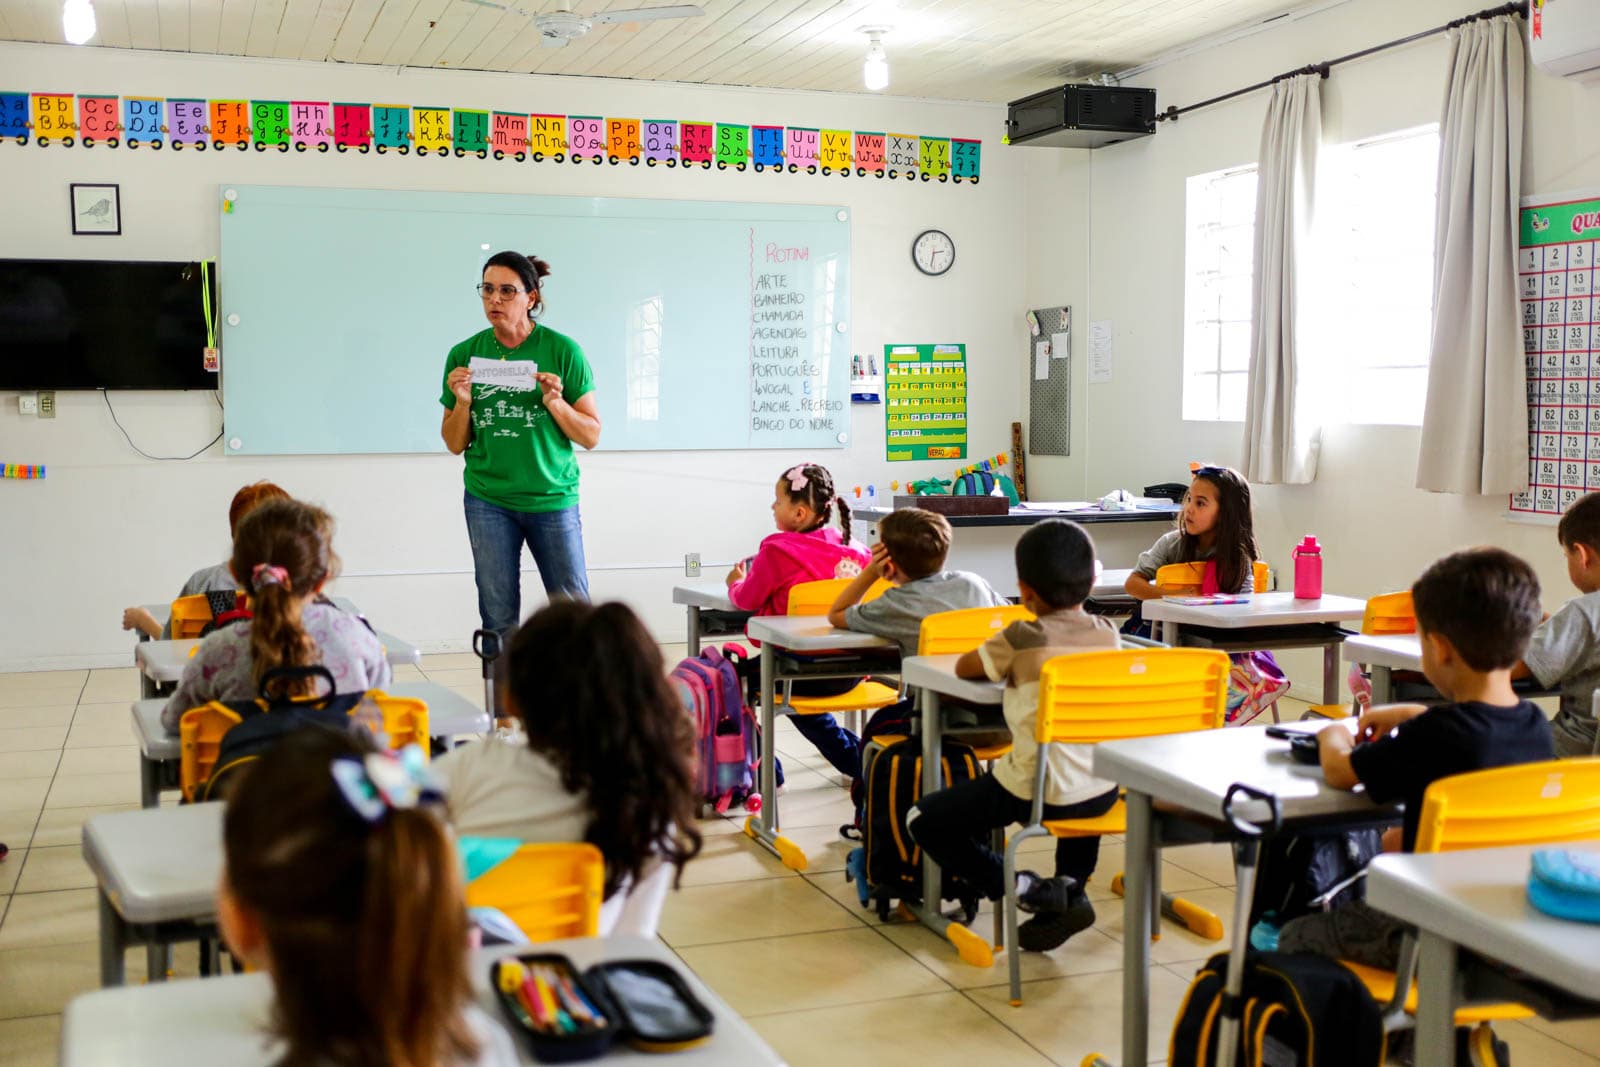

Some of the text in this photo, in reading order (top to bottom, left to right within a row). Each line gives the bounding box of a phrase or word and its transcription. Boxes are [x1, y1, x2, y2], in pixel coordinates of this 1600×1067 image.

[766, 242, 809, 263] ROTINA
[1529, 246, 1582, 262] 1 2 3
[755, 274, 788, 290] ARTE
[1527, 274, 1583, 288] 11 12 13
[753, 294, 804, 308] BANHEIRO
[1526, 301, 1582, 313] 21 22 23
[752, 310, 804, 323] CHAMADA
[753, 327, 807, 340] AGENDAS
[1525, 328, 1581, 339] 31 32 33
[753, 346, 798, 359] LEITURA
[1548, 356, 1556, 366] 42
[1570, 356, 1580, 365] 43
[752, 360, 820, 377] PORTUGUÊS
[762, 381, 811, 395] VOGAL E
[1547, 383, 1579, 392] 52 53
[752, 400, 790, 413] LANCHE
[1545, 410, 1579, 420] 62 63
[753, 417, 834, 430] BINGO DO NOME
[1545, 436, 1577, 446] 72 73
[1544, 463, 1577, 474] 82 83
[1542, 490, 1576, 501] 92 93
